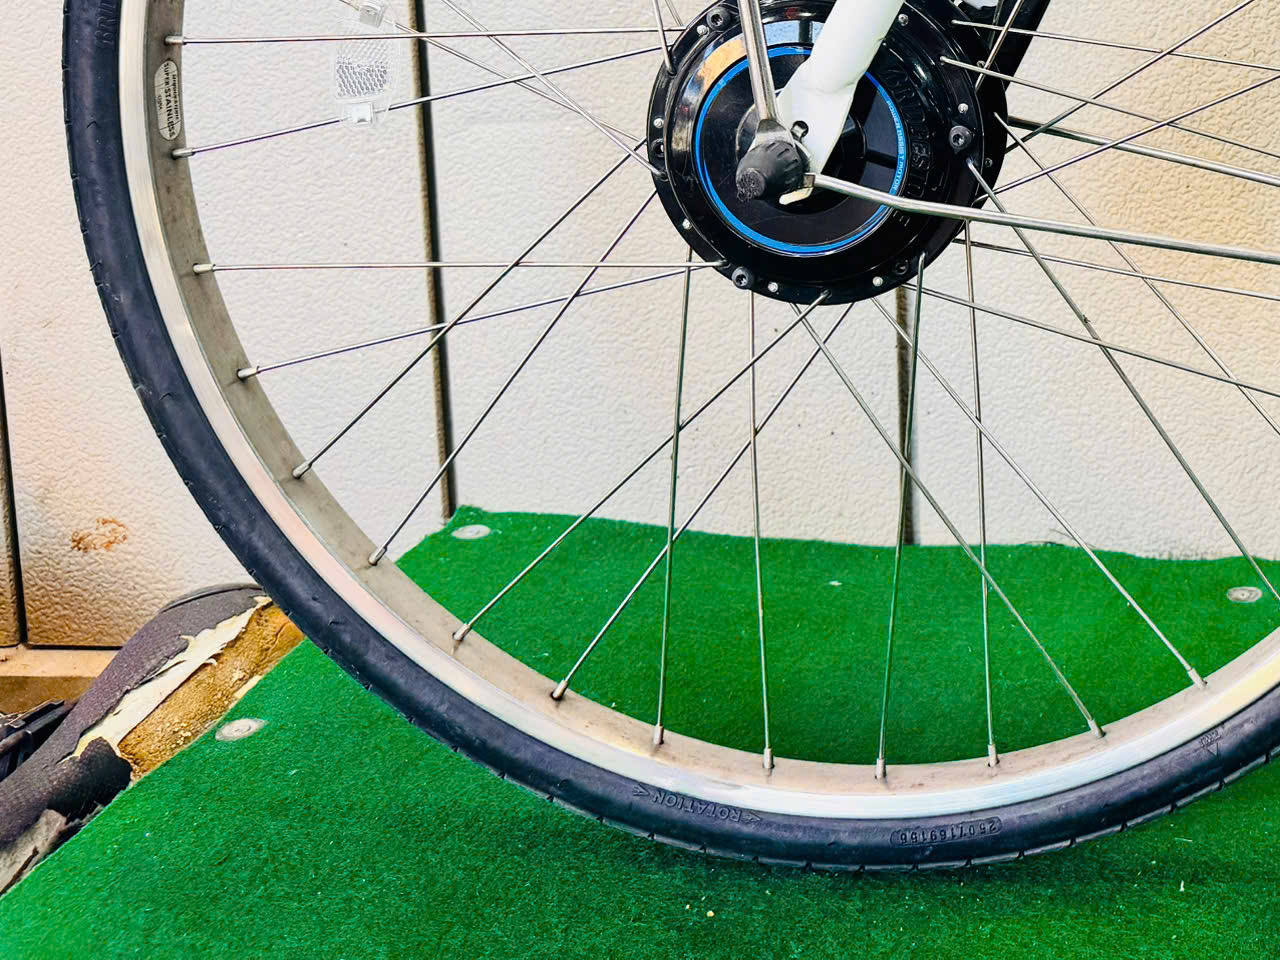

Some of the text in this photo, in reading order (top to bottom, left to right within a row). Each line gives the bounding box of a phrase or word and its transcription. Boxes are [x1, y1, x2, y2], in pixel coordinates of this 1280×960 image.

[164, 88, 176, 138] STAINLESS
[892, 160, 904, 191] MOTOR
[653, 791, 743, 822] ROTATION
